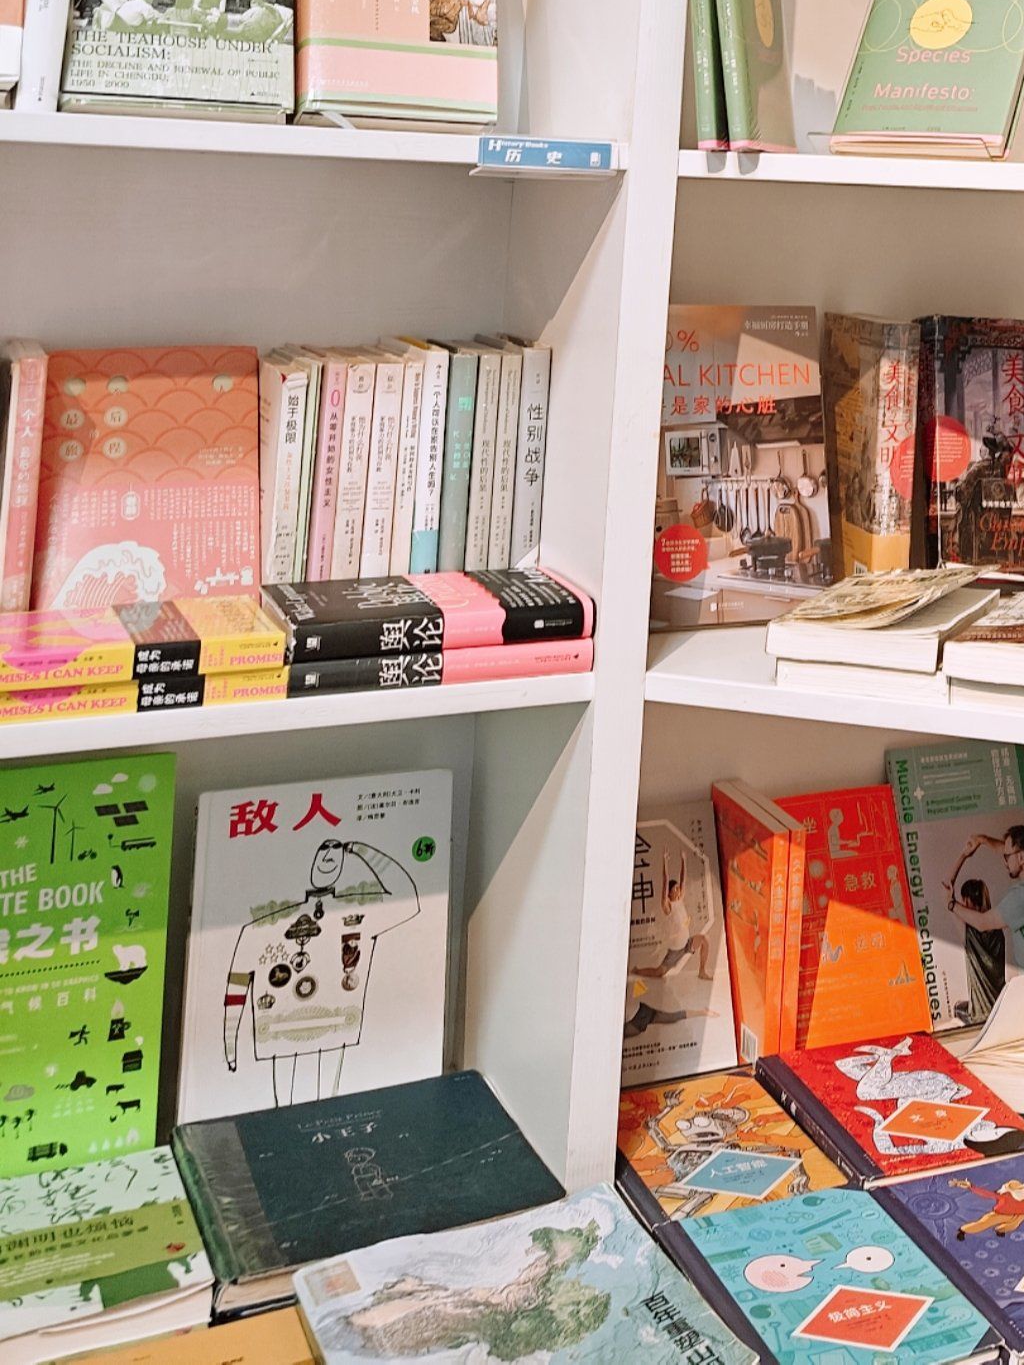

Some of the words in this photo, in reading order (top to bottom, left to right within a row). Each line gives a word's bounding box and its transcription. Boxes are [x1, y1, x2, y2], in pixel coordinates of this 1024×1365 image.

[71, 44, 171, 61] SOCIALISM:
[73, 30, 108, 44] THE
[115, 32, 208, 50] TEAHOUSE
[214, 38, 274, 55] UNDER
[895, 47, 972, 65] Species
[70, 69, 93, 79] LIFE
[71, 59, 93, 69] THE
[97, 60, 143, 72] DECLINE
[147, 63, 170, 73] AND
[174, 65, 224, 77] RENEWAL
[245, 69, 281, 80] PUBLIC
[505, 149, 562, 165] 历史
[700, 363, 810, 386] KITCHEN
[671, 396, 777, 415] 是家的心脏
[285, 394, 299, 444] 始于极限
[523, 404, 543, 487] 性别战争
[322, 413, 338, 508] 从零开始的女性主义
[380, 617, 443, 650] 舆论
[54, 666, 84, 679] CAN
[88, 664, 123, 677] KEEP
[379, 653, 443, 686] 舆论
[57, 699, 88, 712] CAN
[91, 697, 127, 710] KEEP
[229, 793, 342, 839] 敌人
[0, 863, 37, 888] THE
[844, 872, 876, 892] 急救
[38, 881, 105, 909] BOOK
[896, 760, 913, 823] Muscle
[906, 831, 924, 899] Energy
[917, 905, 942, 1022] Techniques
[710, 1157, 768, 1178] 人工智能
[826, 1299, 894, 1324] 极简主义
